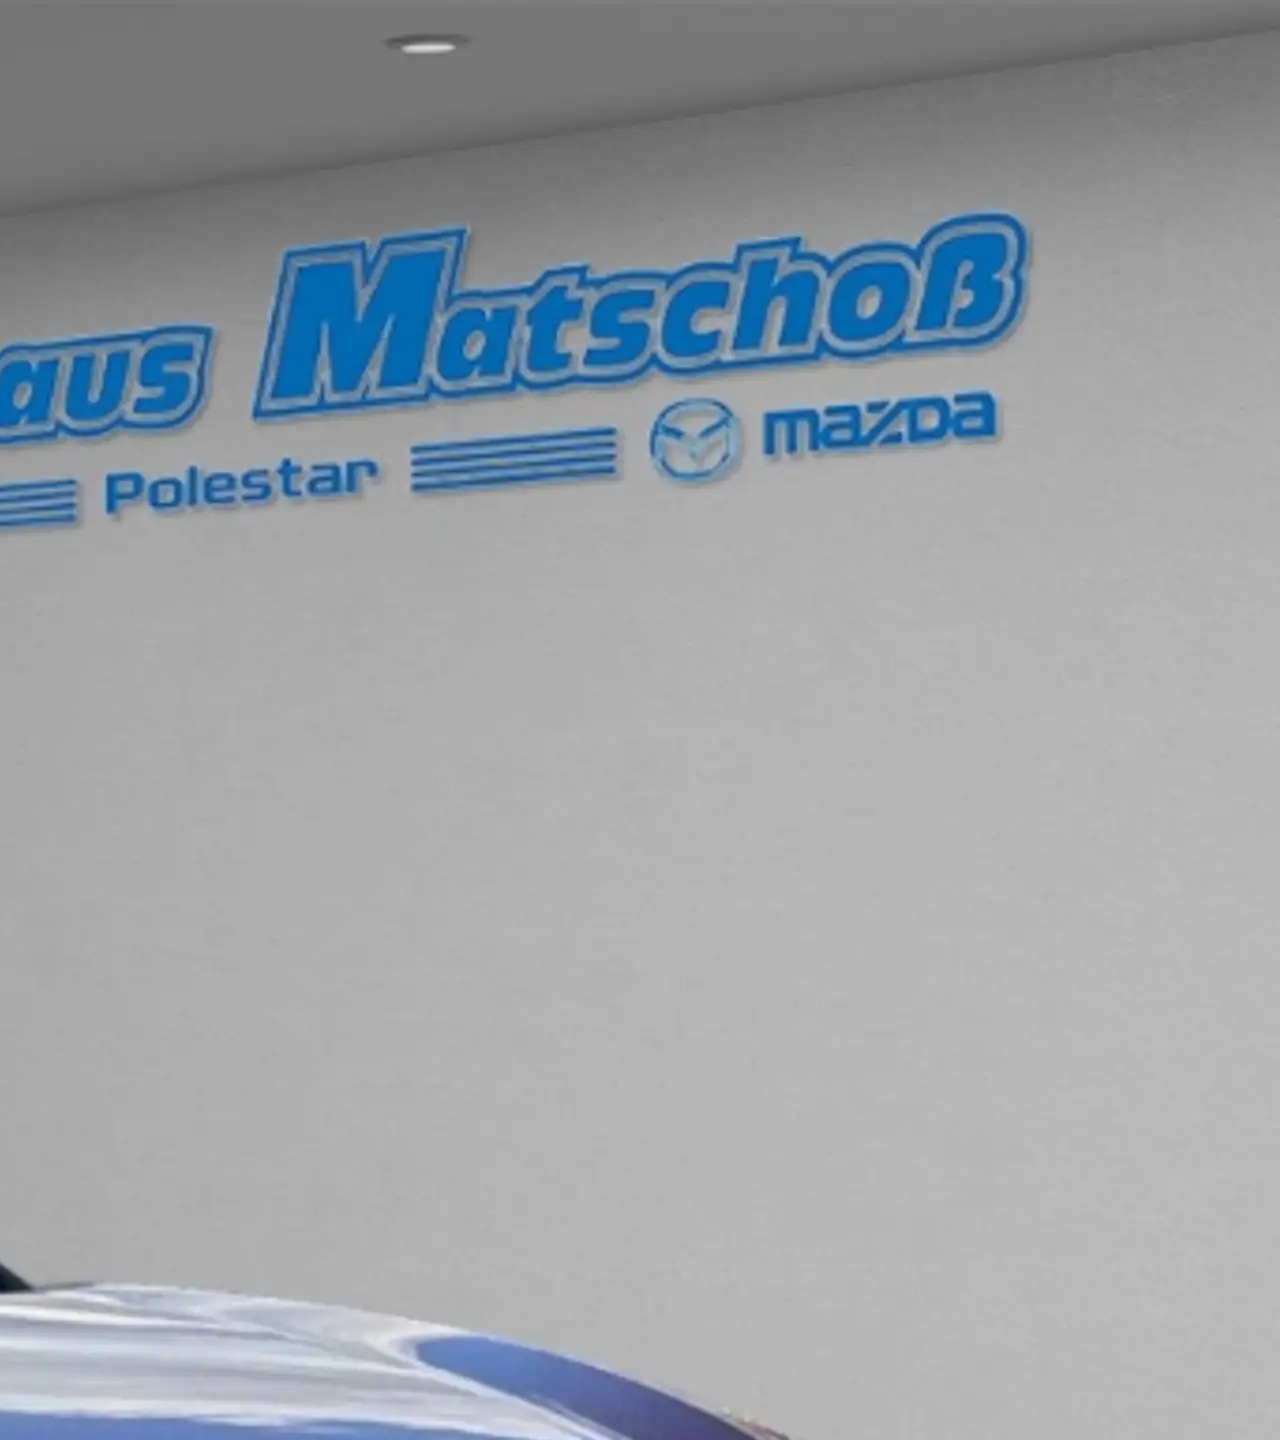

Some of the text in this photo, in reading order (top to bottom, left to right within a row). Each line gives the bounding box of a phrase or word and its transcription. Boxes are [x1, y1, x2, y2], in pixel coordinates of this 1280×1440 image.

[252, 212, 1028, 422] Matschoß
[762, 390, 997, 458] mazda
[104, 455, 378, 516] Polestar
